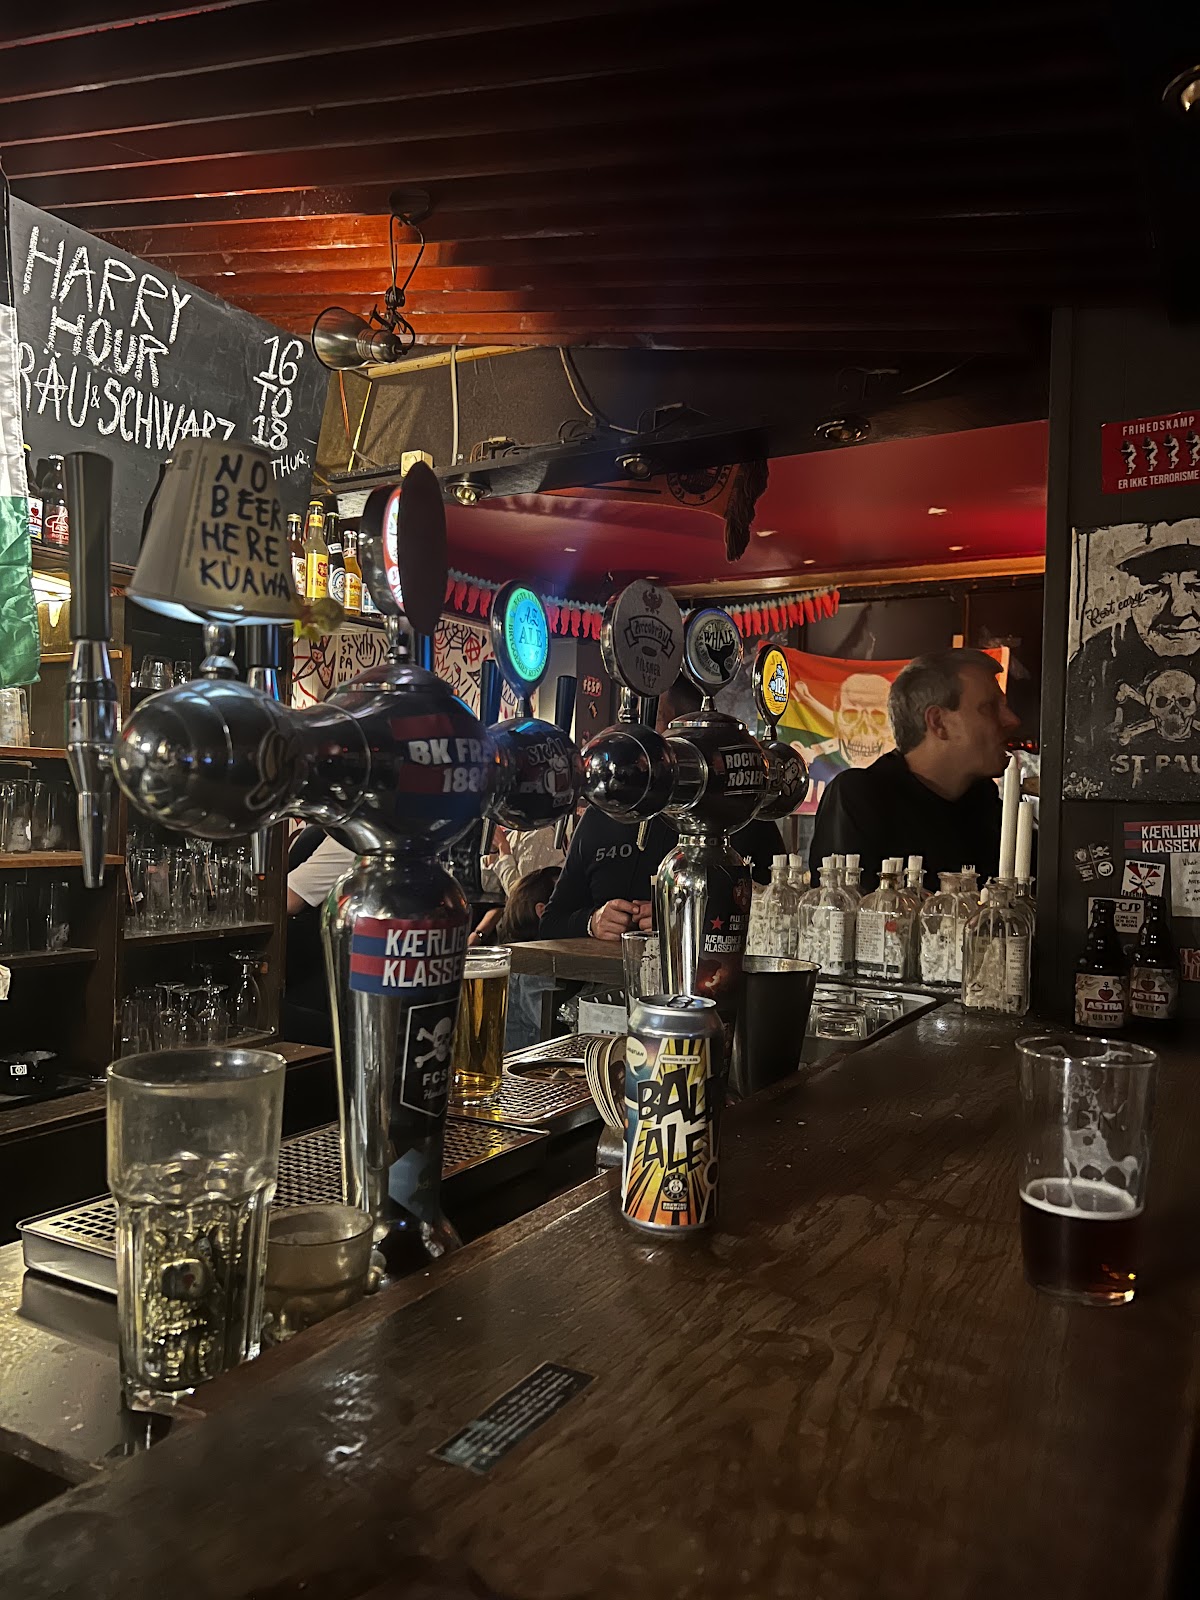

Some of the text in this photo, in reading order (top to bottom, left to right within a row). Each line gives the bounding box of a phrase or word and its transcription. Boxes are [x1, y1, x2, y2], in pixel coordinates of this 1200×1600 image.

[22, 226, 191, 343] HAPPY
[46, 306, 169, 388] HOUR
[263, 336, 304, 386] 16
[250, 415, 288, 451] 18
[1122, 416, 1195, 436] FRIHEDSKAMP
[214, 454, 267, 493] NO
[1118, 469, 1200, 490] ER IKKE TERRORISME
[211, 485, 282, 531] BEER
[202, 522, 280, 567] HERE
[518, 626, 543, 648] ALE
[704, 629, 734, 650] WHALE
[340, 656, 352, 671] PA
[636, 656, 660, 677] PILSNER
[775, 677, 787, 696] IPA
[408, 738, 453, 766] BK
[1142, 824, 1200, 839] KÆRLIGH
[595, 844, 632, 862] 540
[1142, 839, 1200, 853] KLASSEK
[1086, 1001, 1123, 1011] ASTRA
[1132, 991, 1167, 1002] ASTRA
[1135, 1003, 1161, 1011] URTYP
[1093, 1014, 1118, 1022] URTYP
[643, 1123, 707, 1172] ALE
